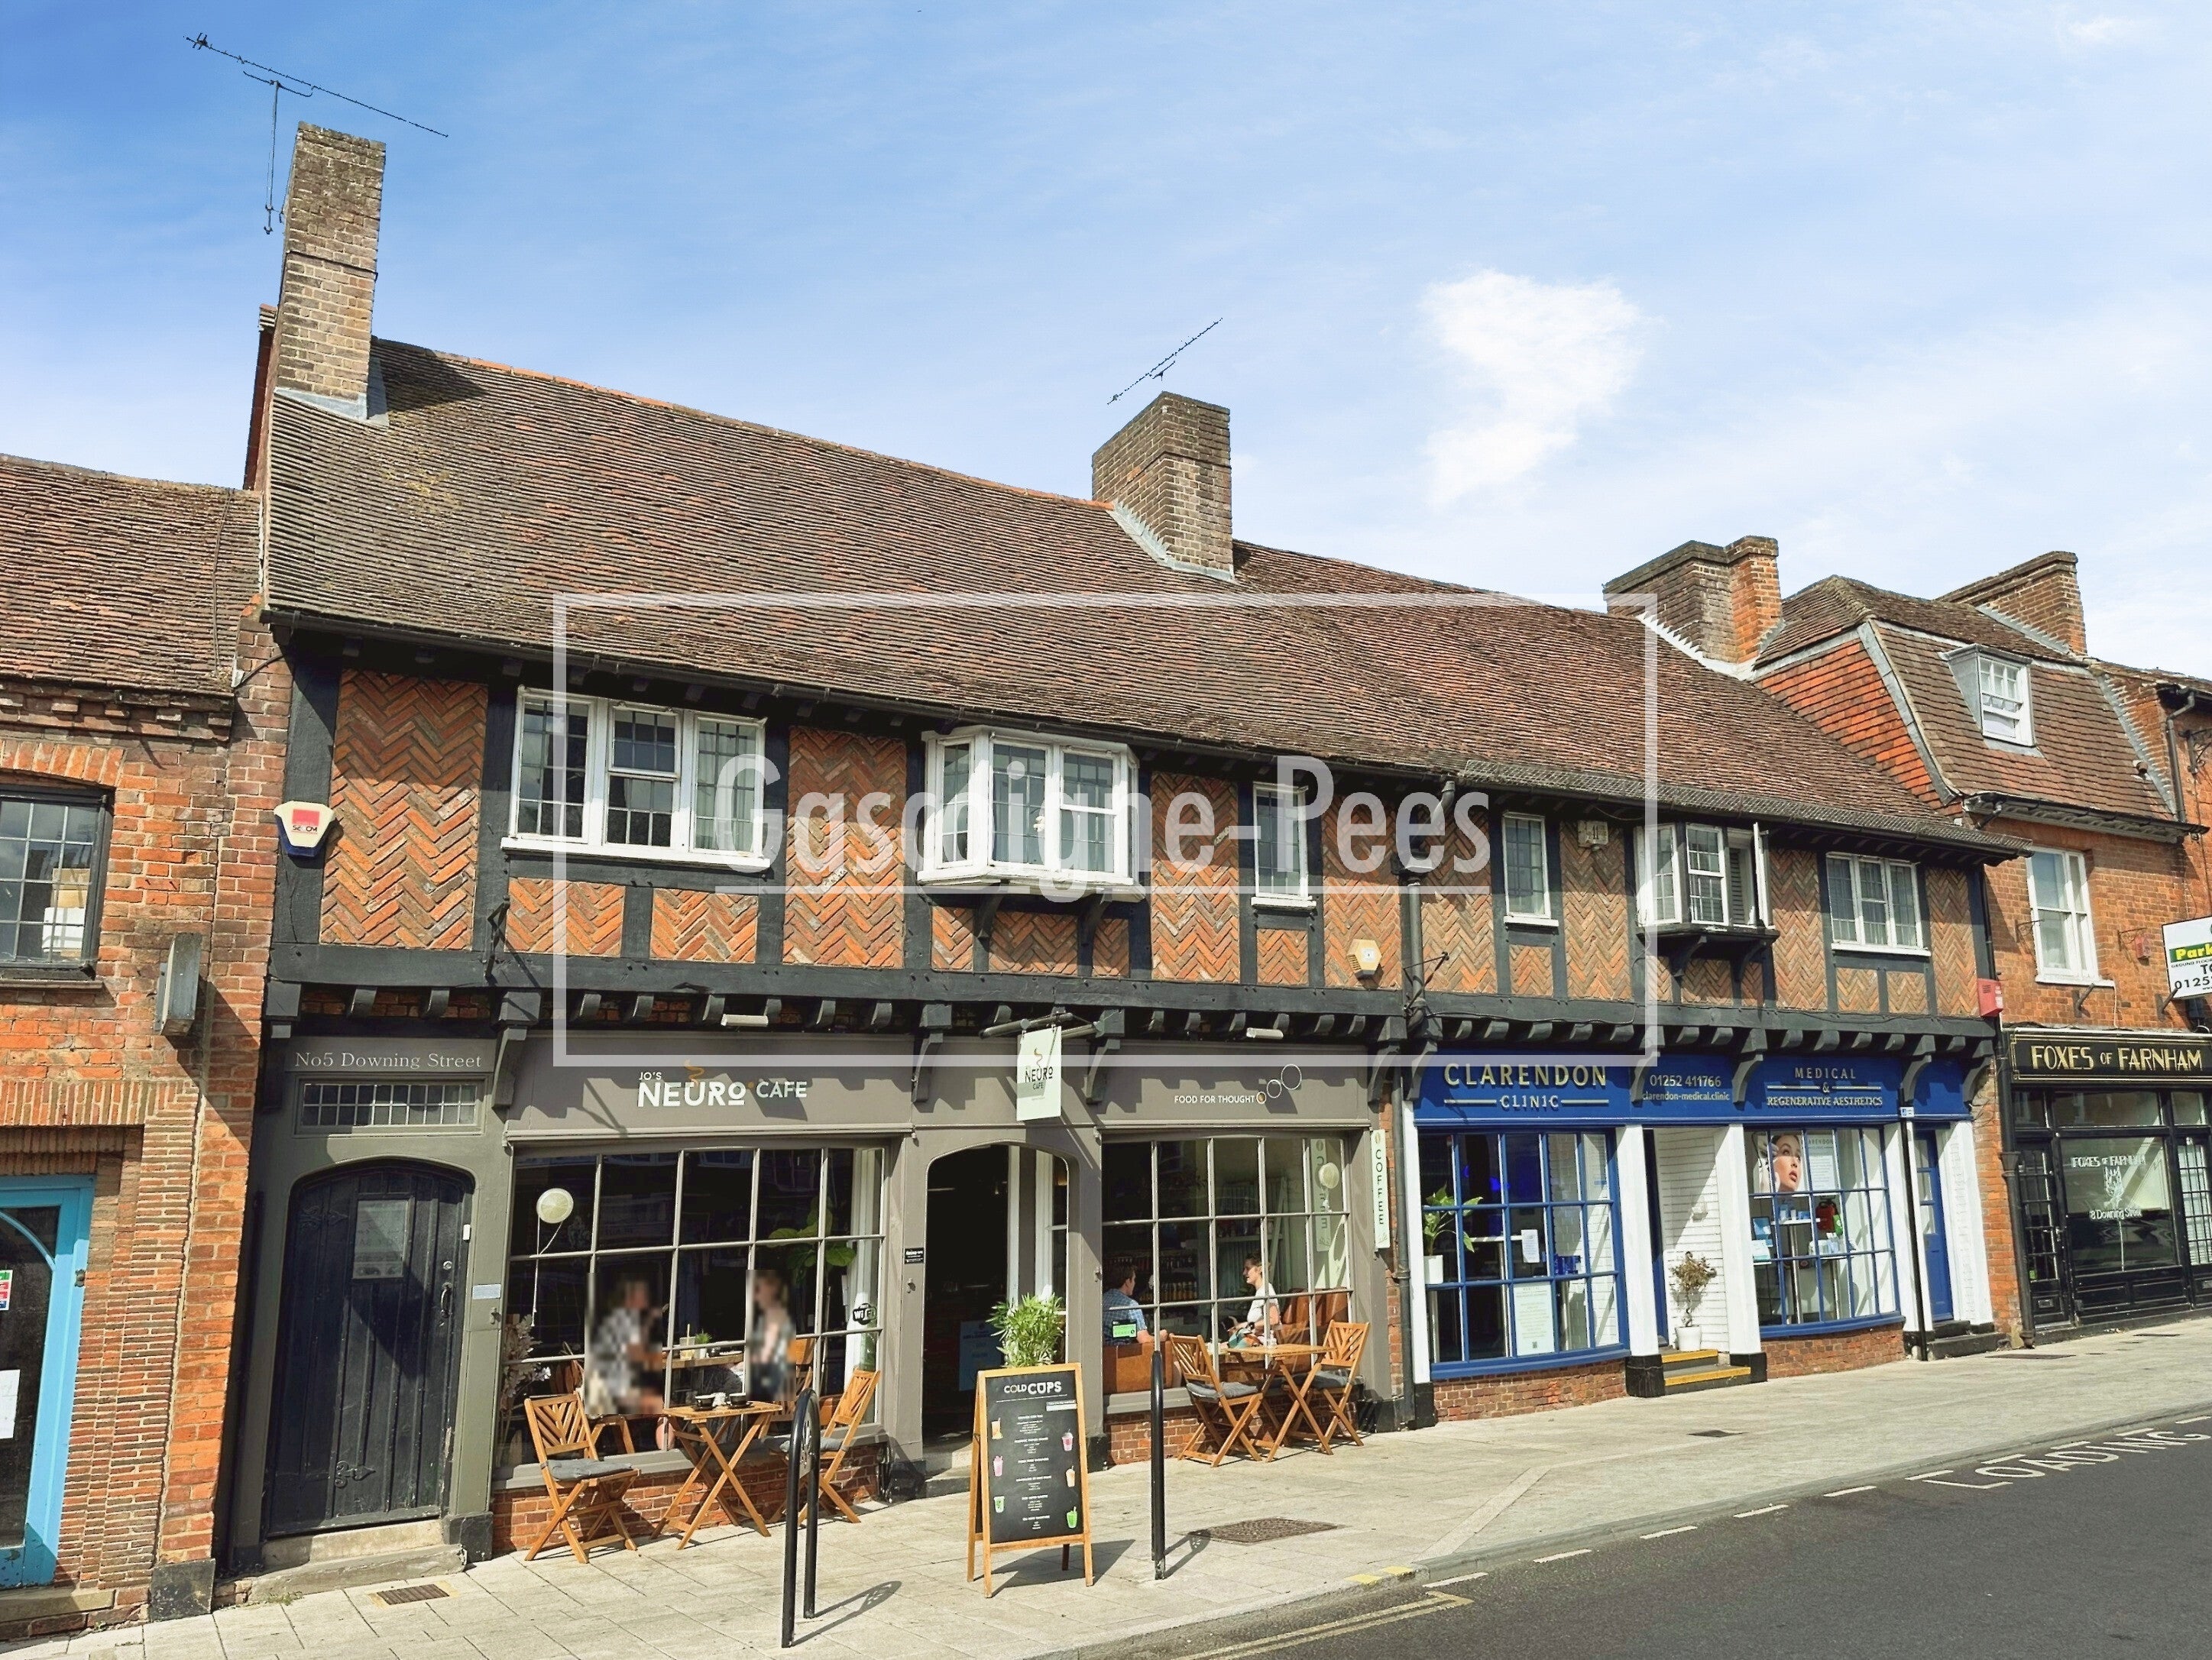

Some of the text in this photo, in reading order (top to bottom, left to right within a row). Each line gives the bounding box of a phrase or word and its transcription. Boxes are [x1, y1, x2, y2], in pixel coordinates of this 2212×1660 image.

[2175, 976, 2212, 989] 0125
[294, 1052, 482, 1069] No5 Downing Street
[2031, 1045, 2203, 1071] FOXES OF FARNHAM
[639, 1071, 662, 1081] JO'S
[1025, 1066, 1054, 1083] NEURO
[1443, 1063, 1606, 1086] CLARENDON
[1795, 1067, 1856, 1079] MEDICAL
[1650, 1074, 1721, 1087] 01252 411766
[1822, 1082, 1830, 1093] &
[637, 1081, 808, 1108] NEURO CAFE
[1174, 1095, 1255, 1104] FOOD FOR THOUGHT
[1500, 1094, 1559, 1108] CLINIC
[1643, 1091, 1730, 1100] clarendon-medical.clinic
[1767, 1096, 1883, 1106] REGENERATIVE AESTHETICS
[2071, 1156, 2101, 1167] FOXES
[1375, 1149, 1385, 1225] COFFEE
[1003, 1380, 1062, 1395] COLD CUPS
[1922, 1431, 2211, 1490] LOADING
